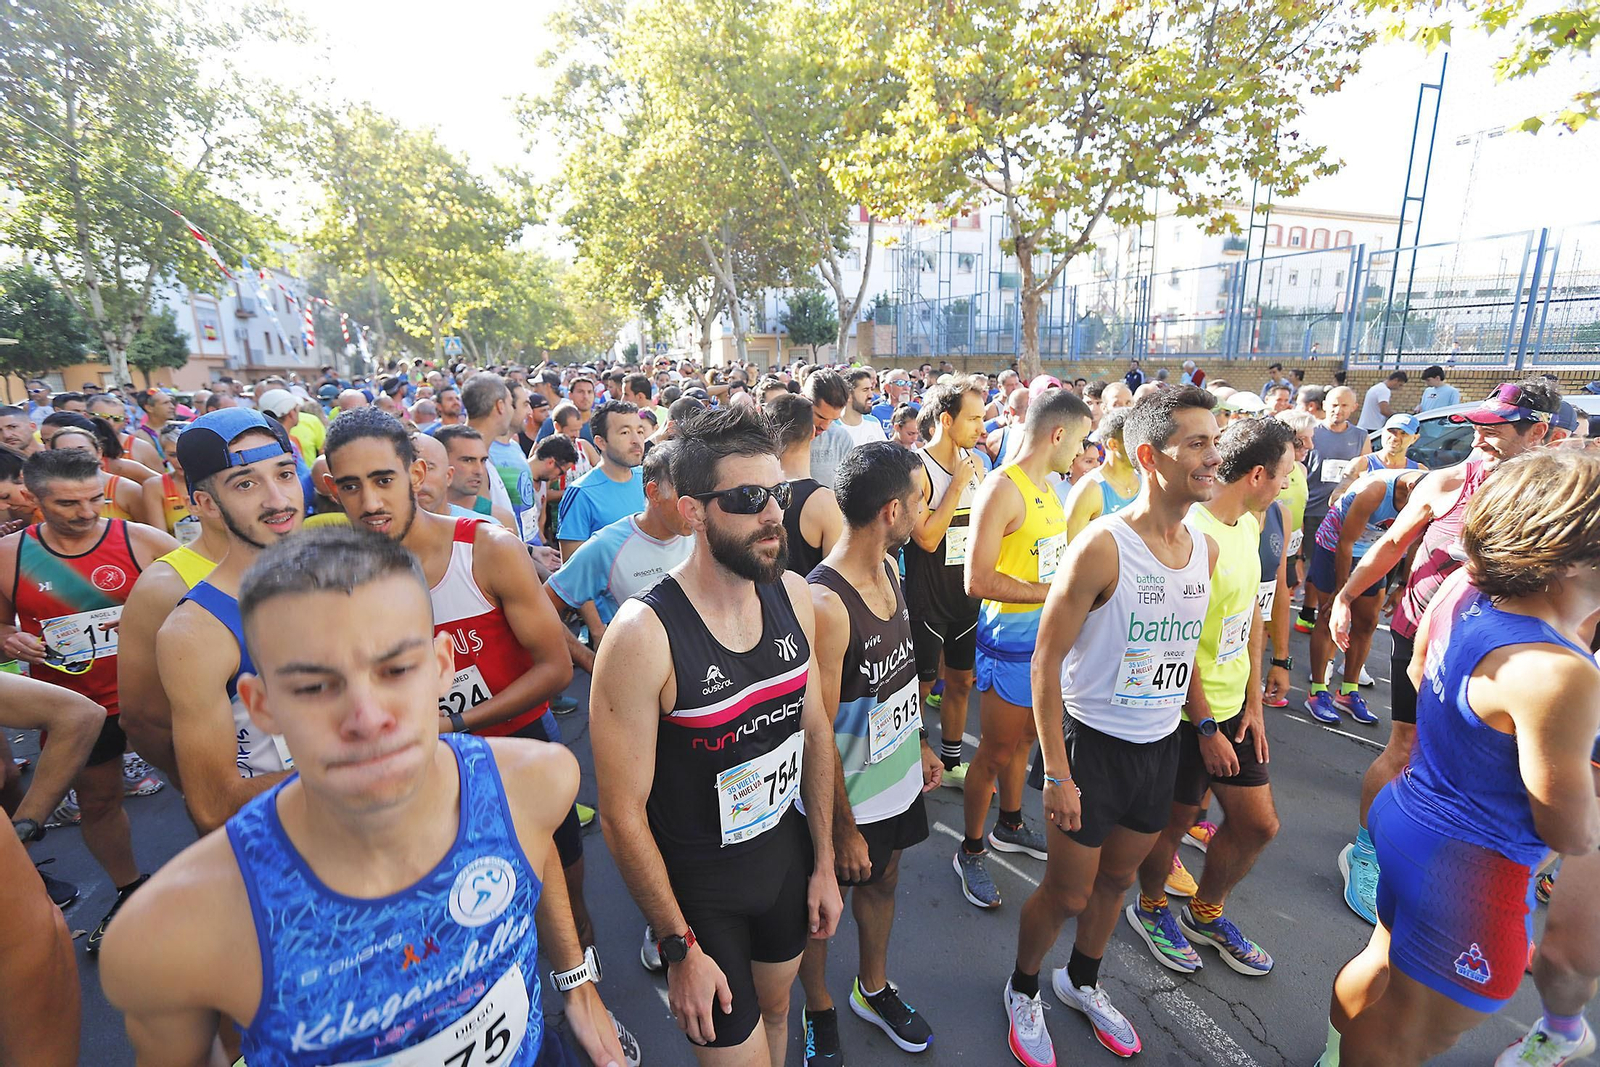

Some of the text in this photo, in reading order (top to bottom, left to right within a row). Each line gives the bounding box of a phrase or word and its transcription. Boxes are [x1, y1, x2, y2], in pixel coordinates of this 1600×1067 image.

[1136, 574, 1166, 584] bathco
[1138, 585, 1164, 593] running
[1137, 592, 1166, 605] TEAM
[1128, 612, 1203, 642] bathco
[1128, 658, 1153, 669] 35 VUELTA
[1163, 650, 1186, 658] ENRIQUE
[1135, 665, 1153, 675] HUELVA
[1152, 662, 1188, 690] 470
[702, 679, 734, 696] austral
[893, 692, 918, 731] 613
[727, 771, 761, 796] 35 VUELTA
[733, 779, 763, 802] A HUELVA
[763, 751, 798, 806] 754
[455, 1002, 494, 1039] DIEGO
[444, 1012, 511, 1067] 75
[806, 1021, 816, 1059] HOKA
